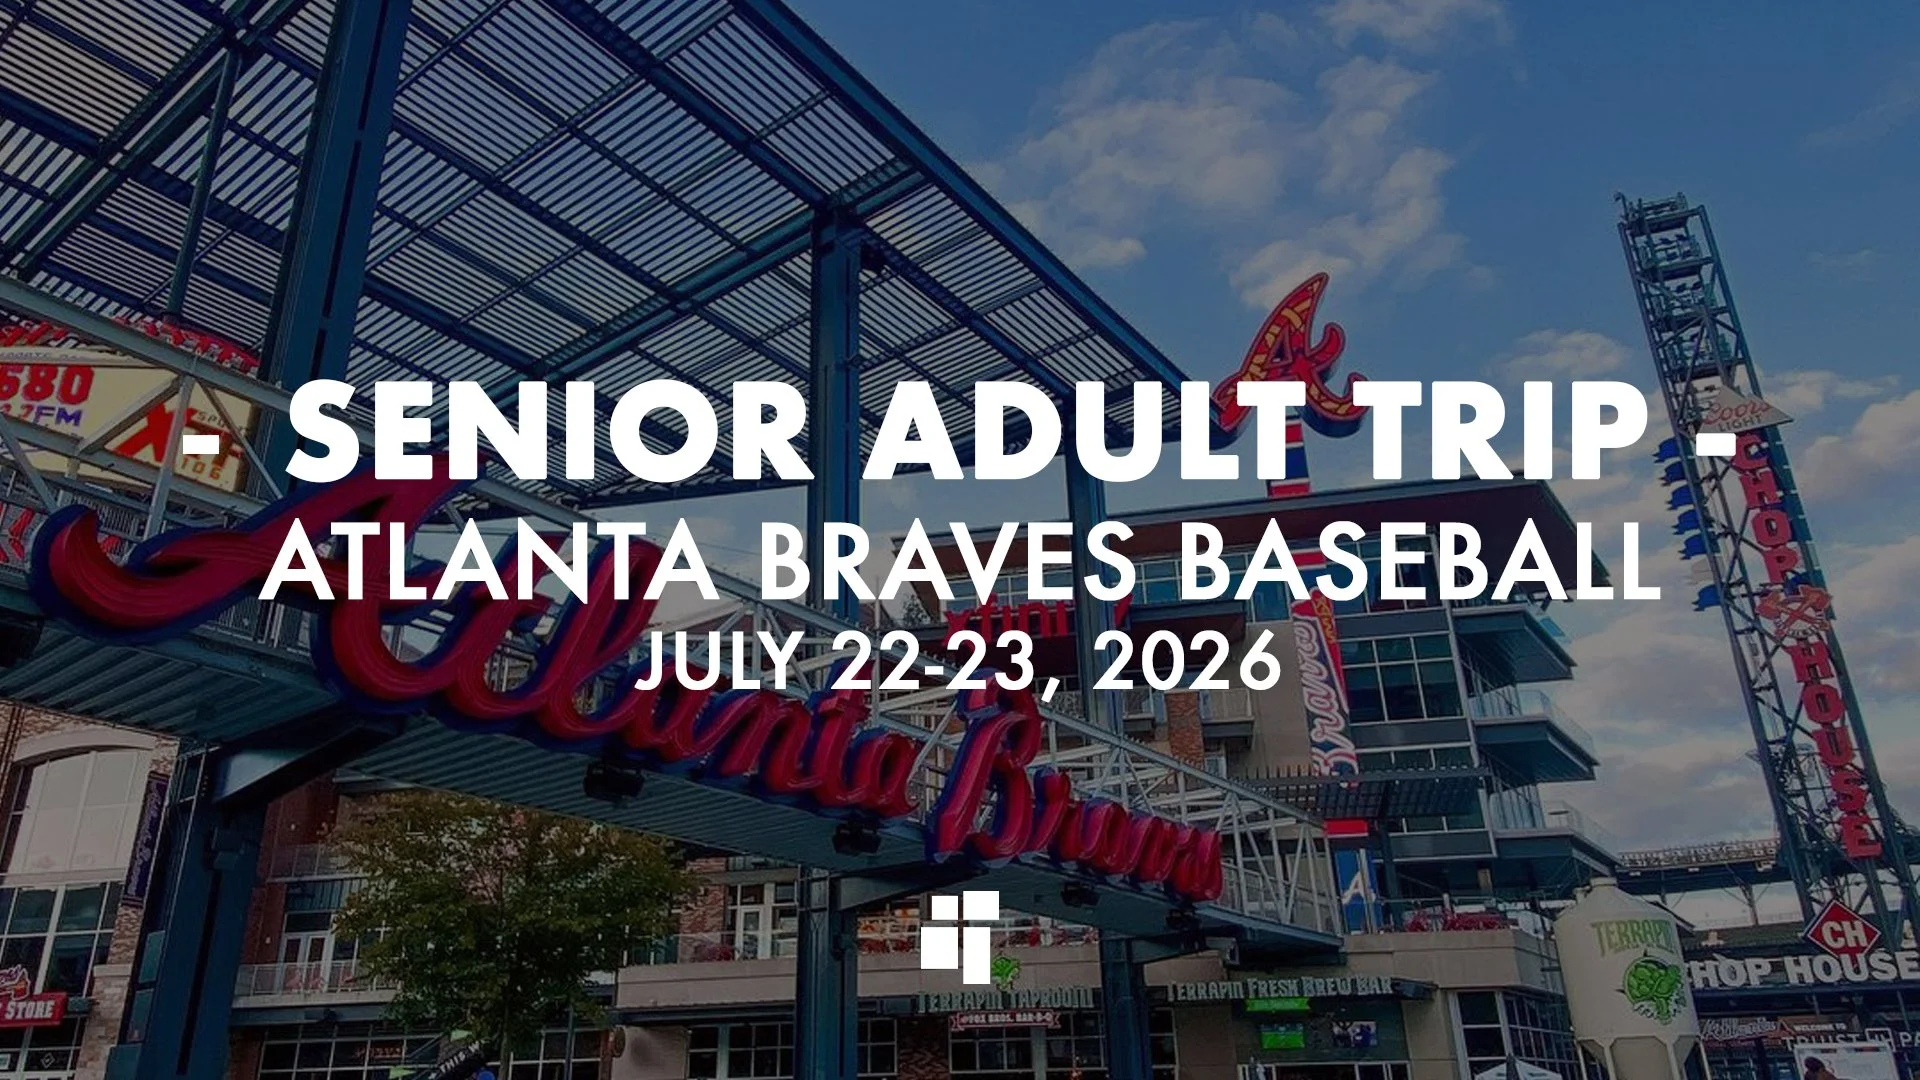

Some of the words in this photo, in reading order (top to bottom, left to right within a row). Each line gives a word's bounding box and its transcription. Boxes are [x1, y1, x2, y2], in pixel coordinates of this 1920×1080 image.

[0, 361, 94, 404] 680
[1702, 401, 1774, 425] Coors
[1718, 413, 1762, 432] LIGHT
[1731, 431, 1798, 585] CHOP
[1785, 641, 1883, 859] HOUSE
[34, 452, 922, 818] Atlanta
[926, 665, 1223, 902] Braves
[1821, 920, 1869, 949] CH
[1686, 955, 1772, 988] HOP
[1783, 950, 1920, 985] HOUSE
[918, 992, 1004, 1013] TERRAPIN
[1009, 987, 1095, 1011] TAPROOM
[1166, 980, 1244, 1002] TERRAPIN
[1247, 976, 1300, 998] FRESH
[1300, 975, 1351, 998] BREW
[1354, 974, 1393, 996] BAR
[4, 1000, 56, 1019] STORE
